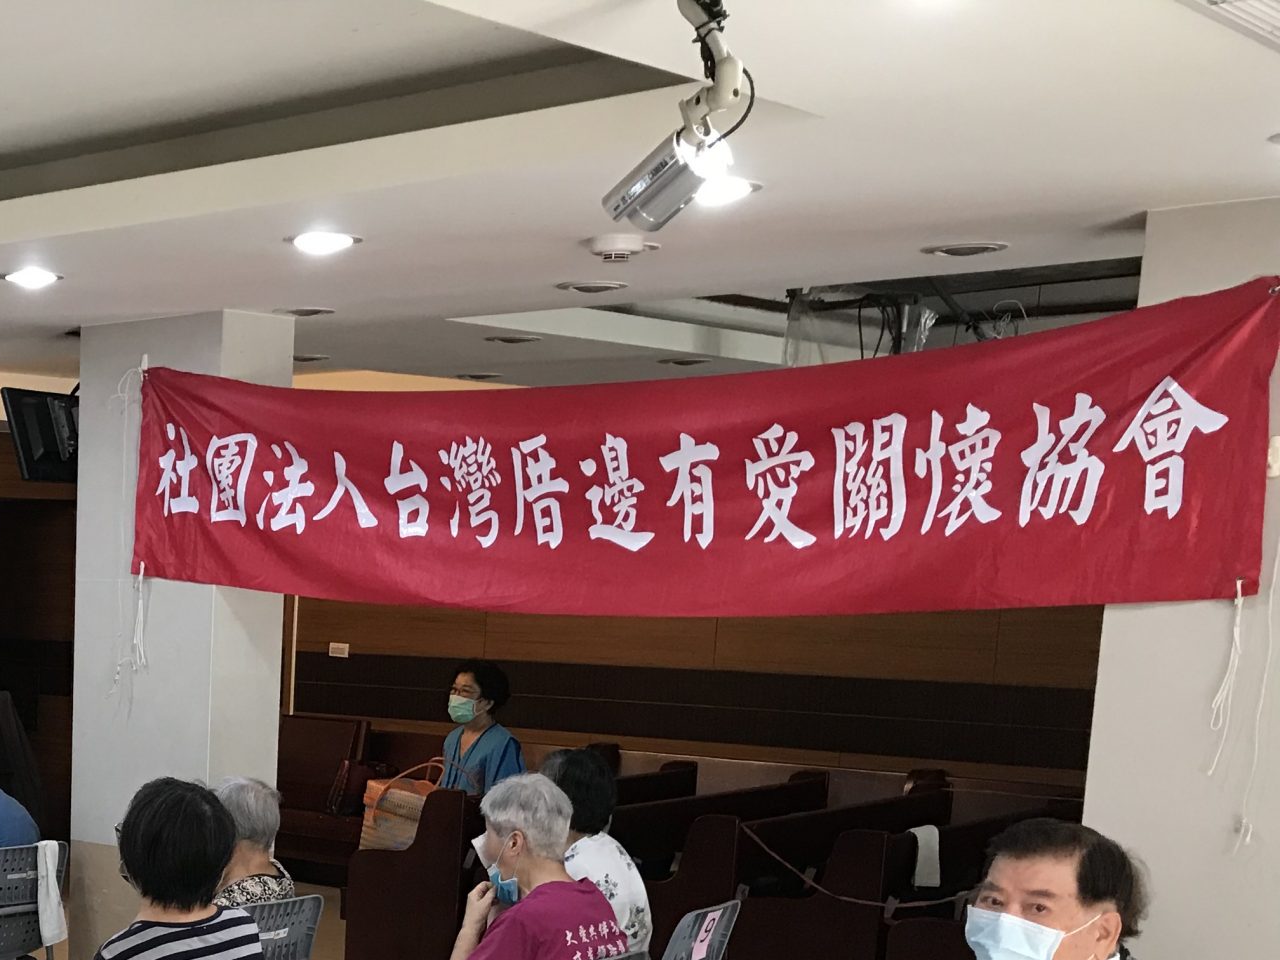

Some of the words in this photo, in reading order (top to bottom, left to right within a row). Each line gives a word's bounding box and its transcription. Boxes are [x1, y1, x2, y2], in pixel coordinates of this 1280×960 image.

[154, 376, 1229, 550] 社團法人台灣厝邊有愛關懷協會
[699, 918, 716, 943] 9
